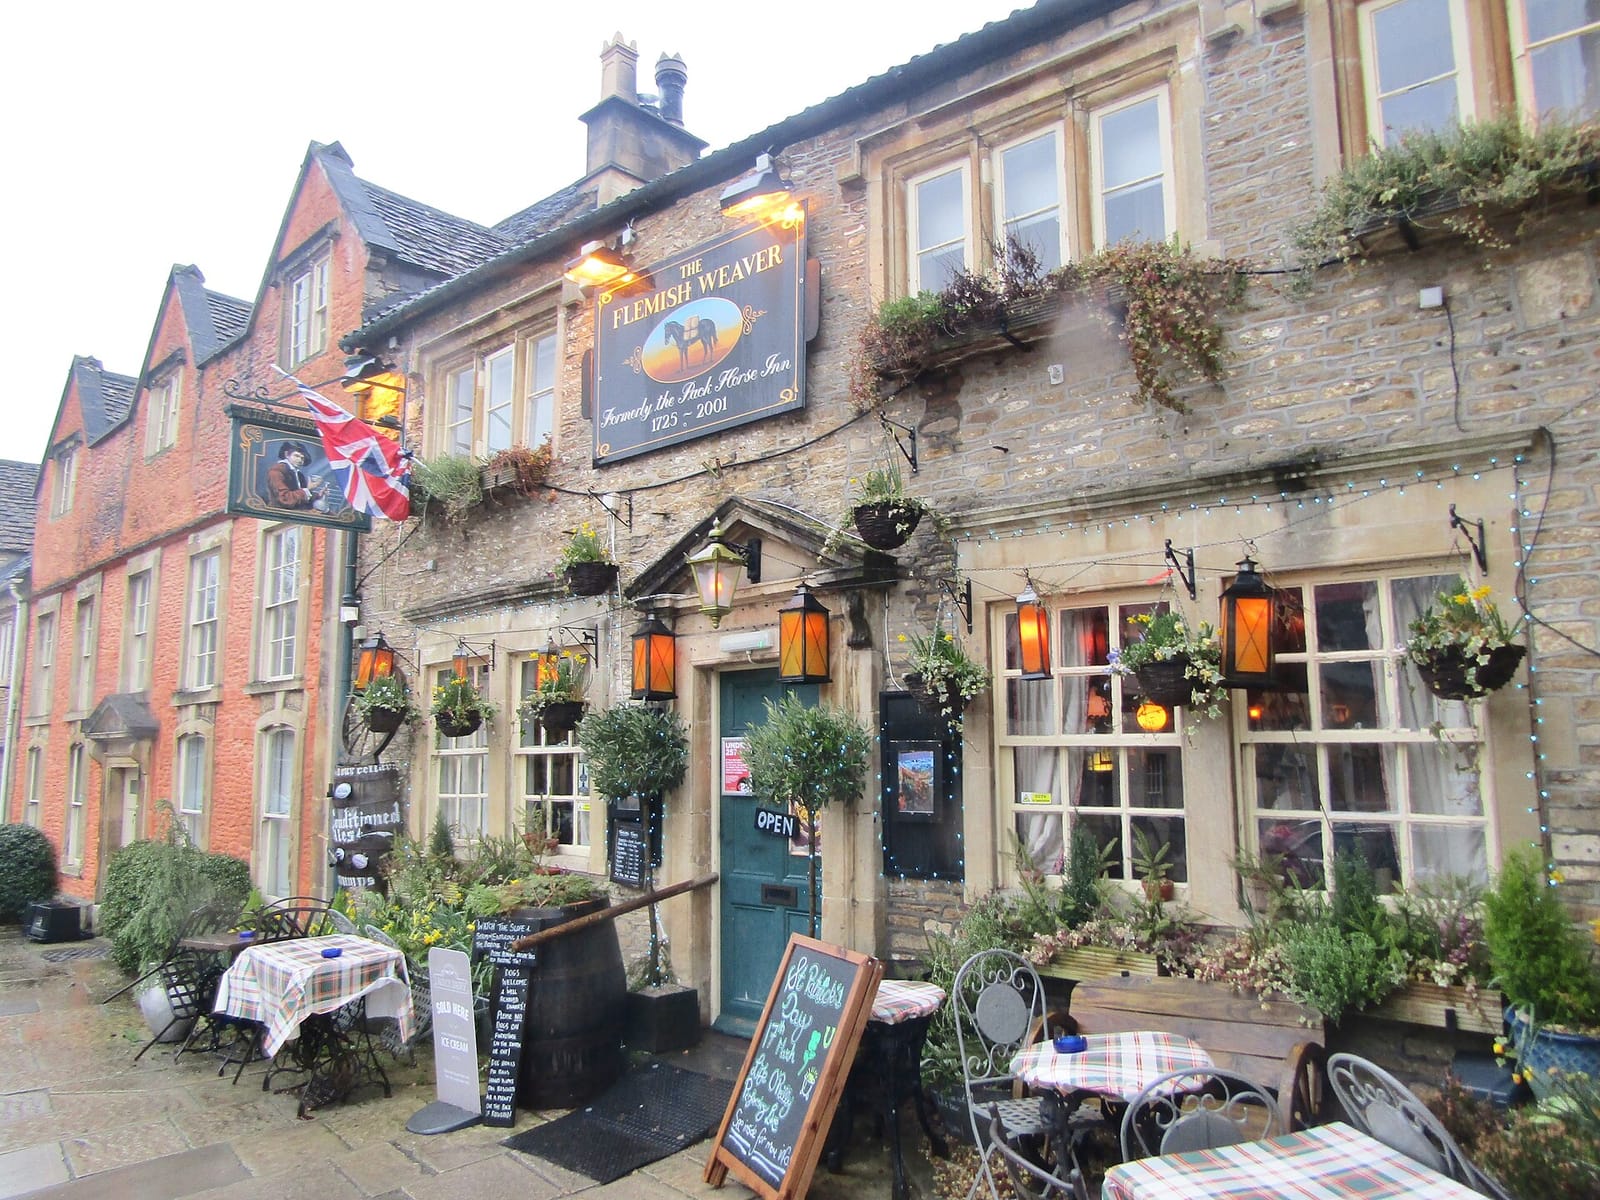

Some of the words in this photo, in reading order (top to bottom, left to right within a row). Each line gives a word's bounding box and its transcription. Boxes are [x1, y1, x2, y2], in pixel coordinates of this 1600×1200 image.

[680, 258, 703, 279] THE
[612, 281, 692, 330] FLEMISH
[699, 244, 784, 295] WEAVER
[600, 401, 652, 428] Formerly
[654, 390, 676, 411] the
[677, 378, 713, 403] Pack
[714, 365, 758, 391] Horse
[760, 352, 792, 377] Inn
[253, 409, 273, 422] THE
[651, 411, 678, 432] 1725
[696, 396, 728, 419] 2001
[757, 810, 794, 837] OPEN
[501, 977, 528, 986] WELCOME
[504, 968, 520, 977] DOGS
[784, 956, 808, 993] St
[436, 1001, 452, 1014] SOLD
[452, 1002, 470, 1021] HERE
[514, 1013, 523, 1021] NO
[781, 991, 813, 1043] Day
[495, 1021, 509, 1031] DOGS
[441, 1036, 450, 1048] ICE
[732, 1108, 745, 1132] See
[748, 1127, 767, 1156] for
